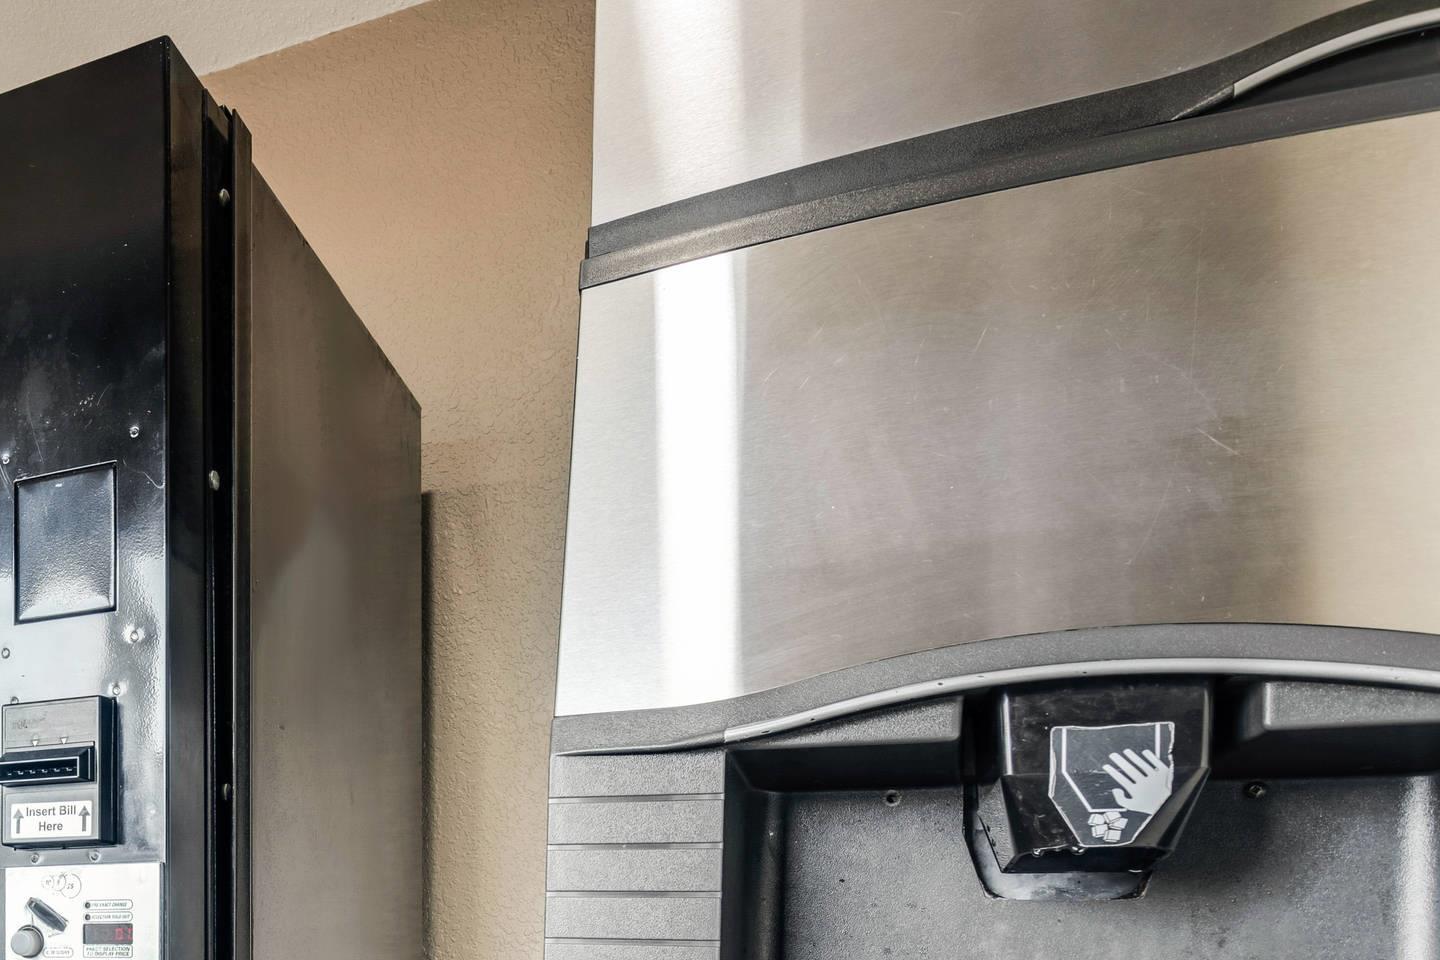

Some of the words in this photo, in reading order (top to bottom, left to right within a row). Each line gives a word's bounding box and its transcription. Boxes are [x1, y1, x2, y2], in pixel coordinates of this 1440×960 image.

[26, 807, 56, 817] Insert
[59, 805, 77, 816] Bill
[38, 822, 64, 832] Here
